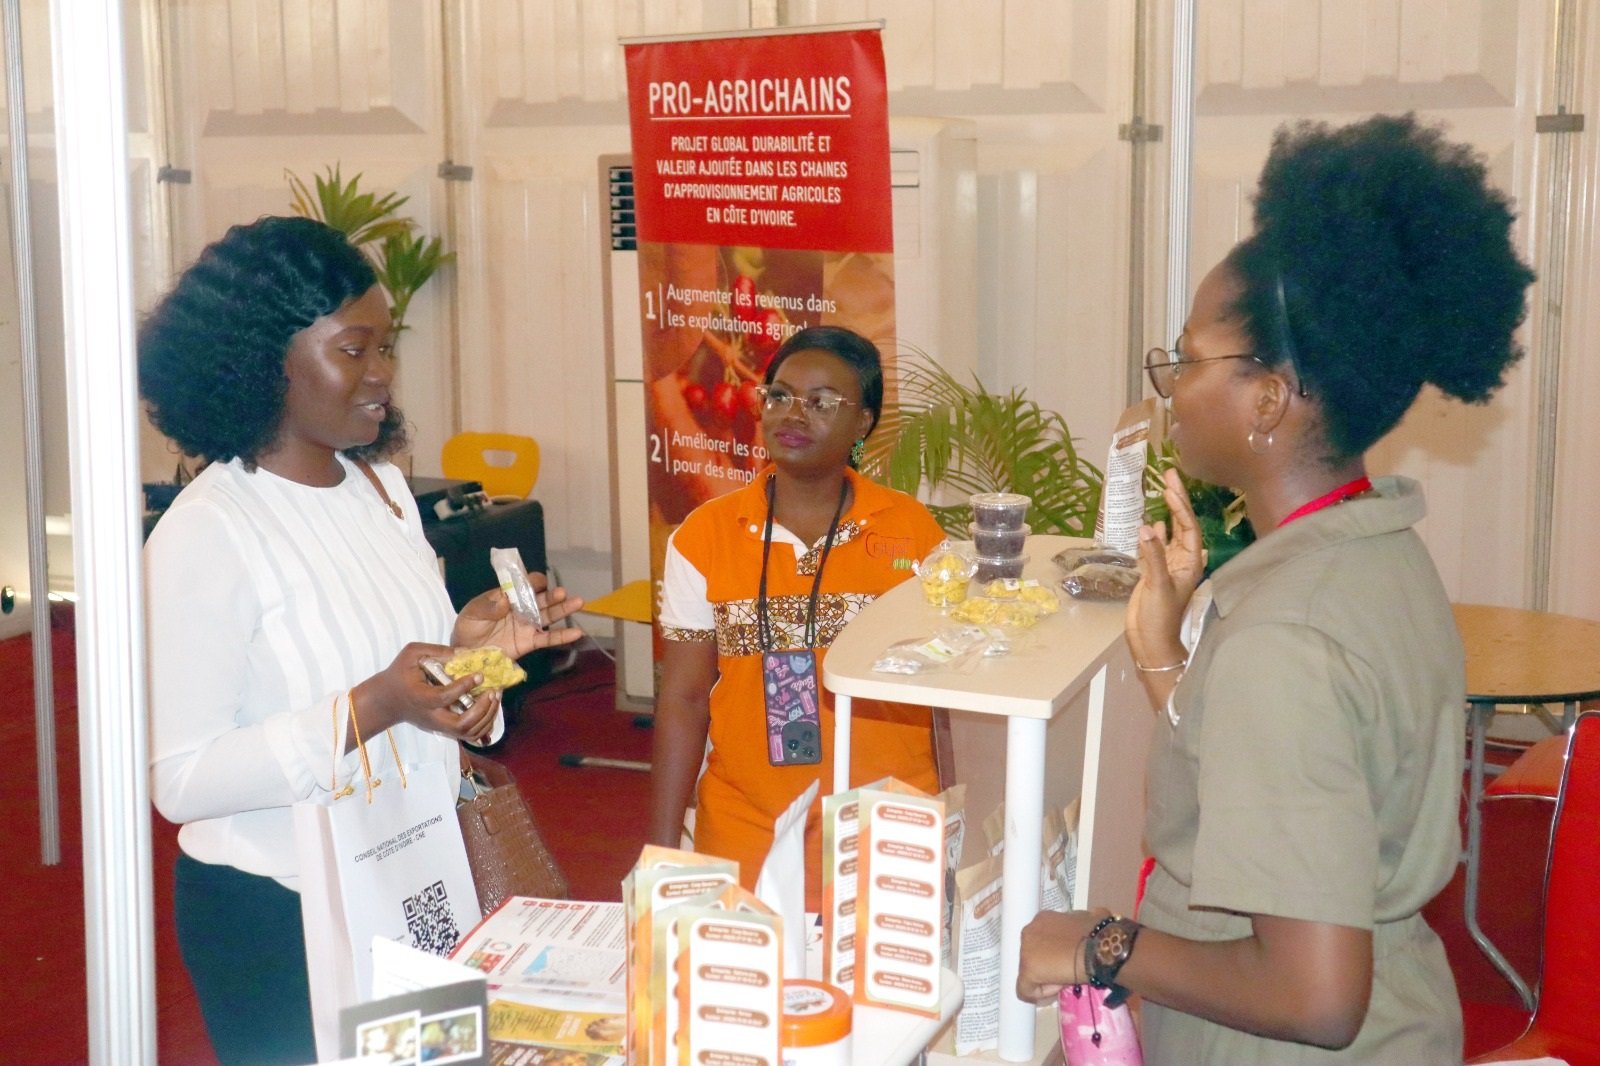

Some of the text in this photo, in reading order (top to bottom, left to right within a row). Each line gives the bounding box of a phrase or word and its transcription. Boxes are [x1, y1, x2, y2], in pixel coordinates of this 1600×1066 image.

[650, 76, 851, 115] PRO-AGRICHAINS
[671, 132, 831, 152] PROJET GLOBAL DURABILITÉ ET
[656, 157, 848, 178] VALEUR AJOUTÉE DANS LES CHAINES
[664, 183, 841, 204] D'APPROVISIONNEMENT AGRICOLES
[706, 204, 797, 227] EN CÔTE D'IVOIRE.
[645, 291, 656, 320] 1
[667, 284, 836, 313] Augmenter les revenus dans
[667, 311, 685, 326] les
[688, 312, 763, 335] exploitations
[651, 434, 662, 463] 2
[672, 430, 730, 451] Améliorer
[733, 438, 749, 456] les
[673, 459, 701, 475] pour
[704, 460, 724, 477] des
[354, 847, 377, 862] CONSEIL
[397, 831, 408, 841] DES
[406, 814, 443, 837] EXPORTATIONS
